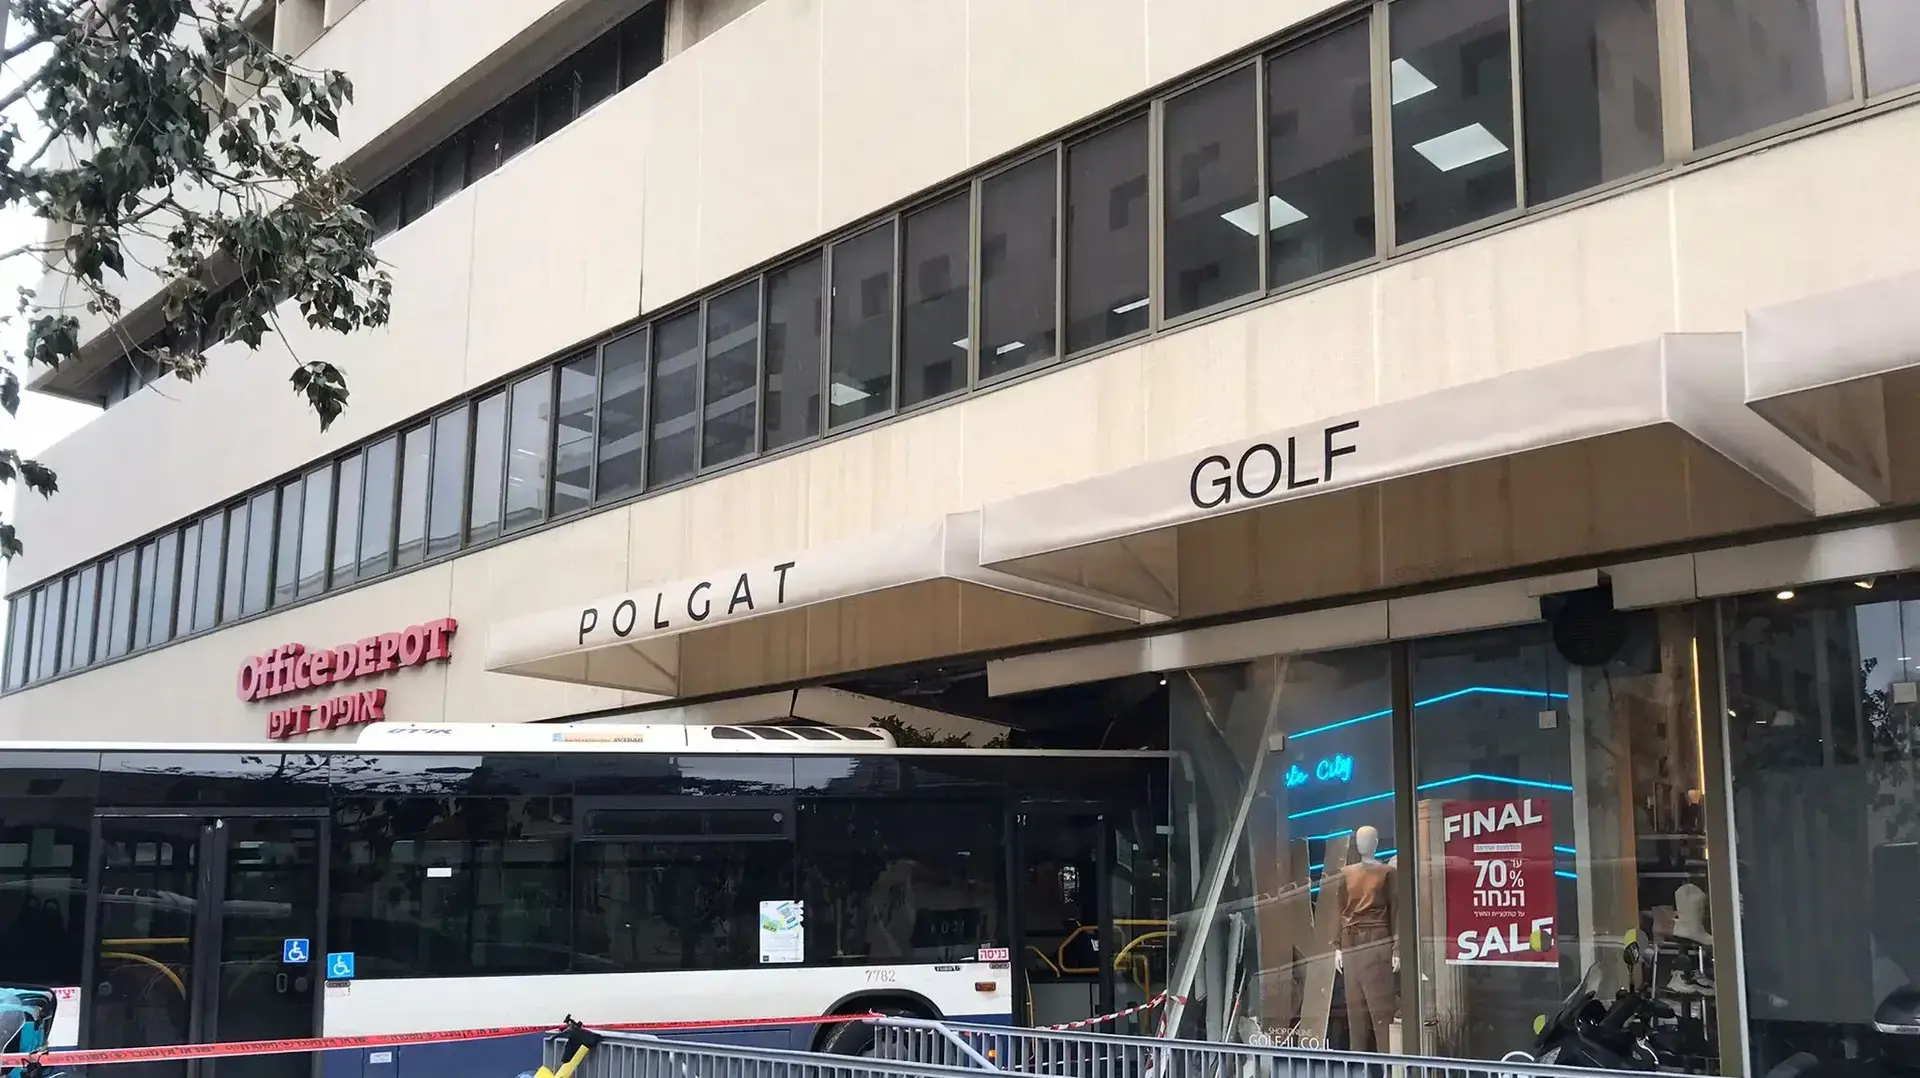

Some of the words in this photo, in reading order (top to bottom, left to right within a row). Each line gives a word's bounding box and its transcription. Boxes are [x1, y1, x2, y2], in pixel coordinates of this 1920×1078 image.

[1190, 420, 1360, 509] GOLF
[578, 561, 796, 645] POLGAT
[266, 704, 311, 740] דיפו
[318, 688, 387, 730] אופיס
[1316, 753, 1352, 782] City
[1443, 799, 1543, 842] FINAL
[1511, 859, 1522, 869] עד
[1473, 890, 1525, 907] הנחה
[980, 949, 1007, 959] כניסה
[1457, 917, 1554, 960] SALE
[865, 969, 896, 983] 7782
[1268, 1027, 1286, 1035] SHOP
